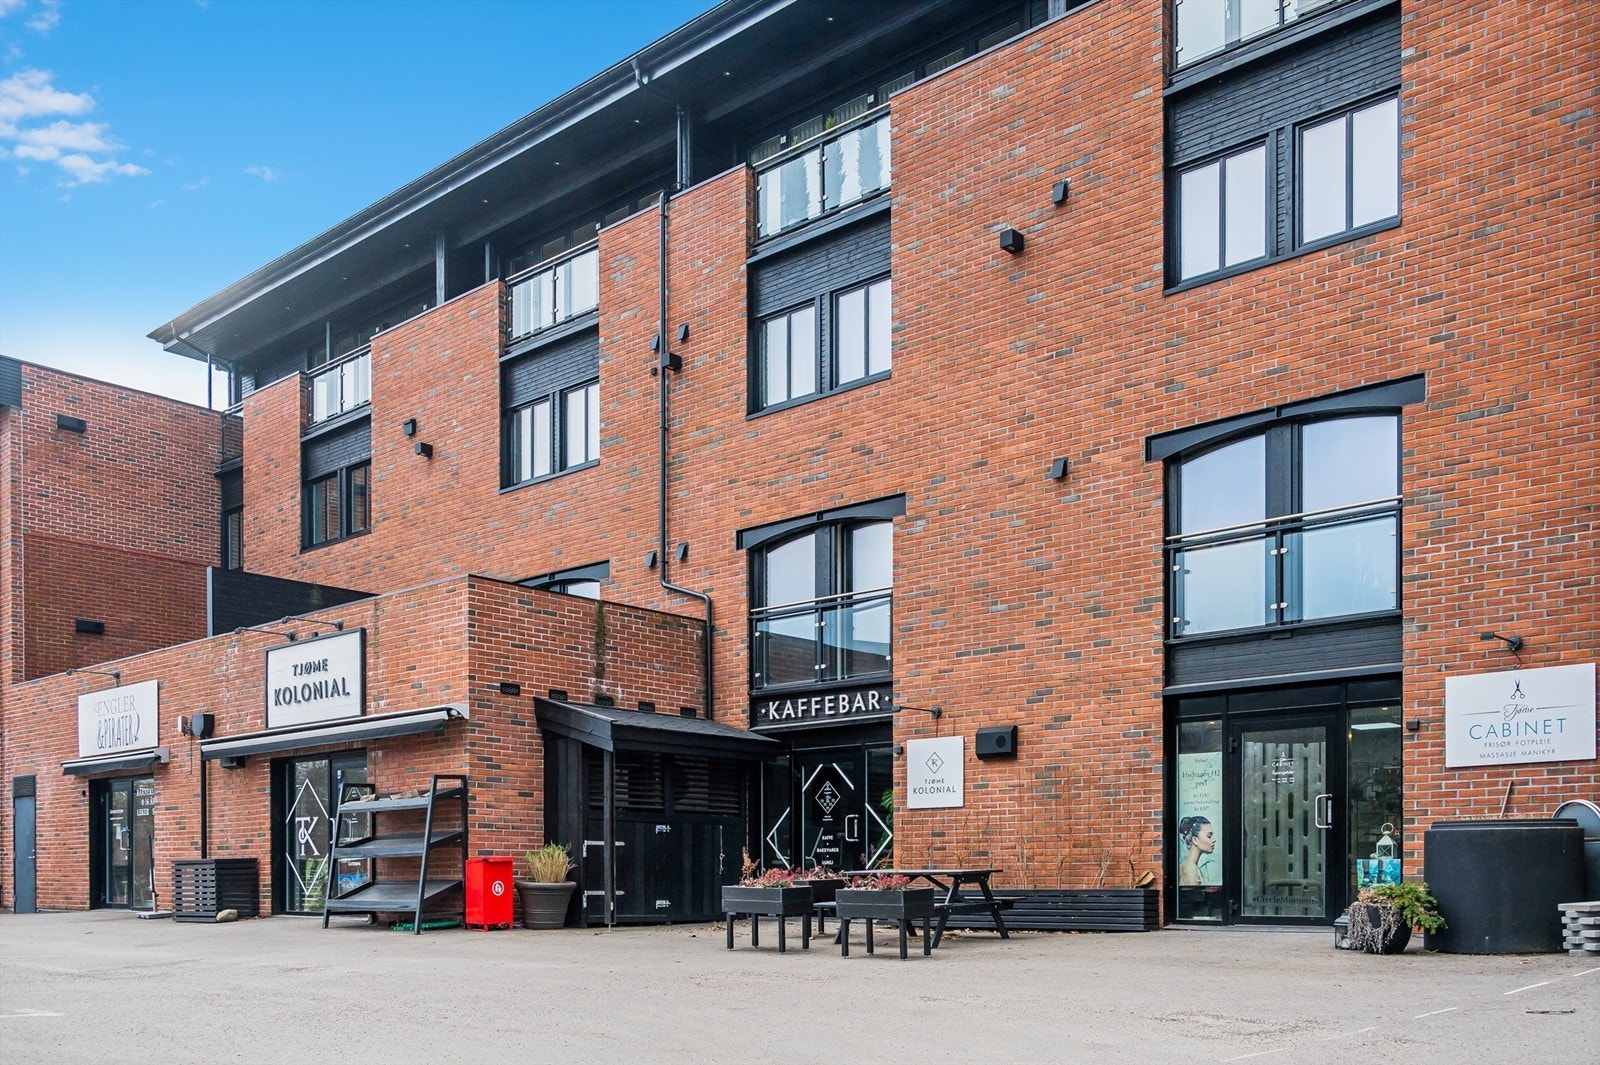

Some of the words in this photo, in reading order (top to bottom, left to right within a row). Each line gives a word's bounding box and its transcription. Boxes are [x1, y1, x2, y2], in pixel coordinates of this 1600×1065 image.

[292, 658, 328, 676] TJØME
[274, 677, 350, 706] KOLONIAL
[97, 695, 136, 717] ENGLER
[769, 690, 880, 720] KAFFEBAR
[1503, 703, 1535, 721] Tjøme
[1469, 718, 1567, 740] CABINET
[1484, 740, 1511, 748] FRISØR
[1515, 738, 1551, 747] FOTPLEIE
[1479, 751, 1517, 759] MASSASJE
[912, 786, 956, 794] KOLONIAL
